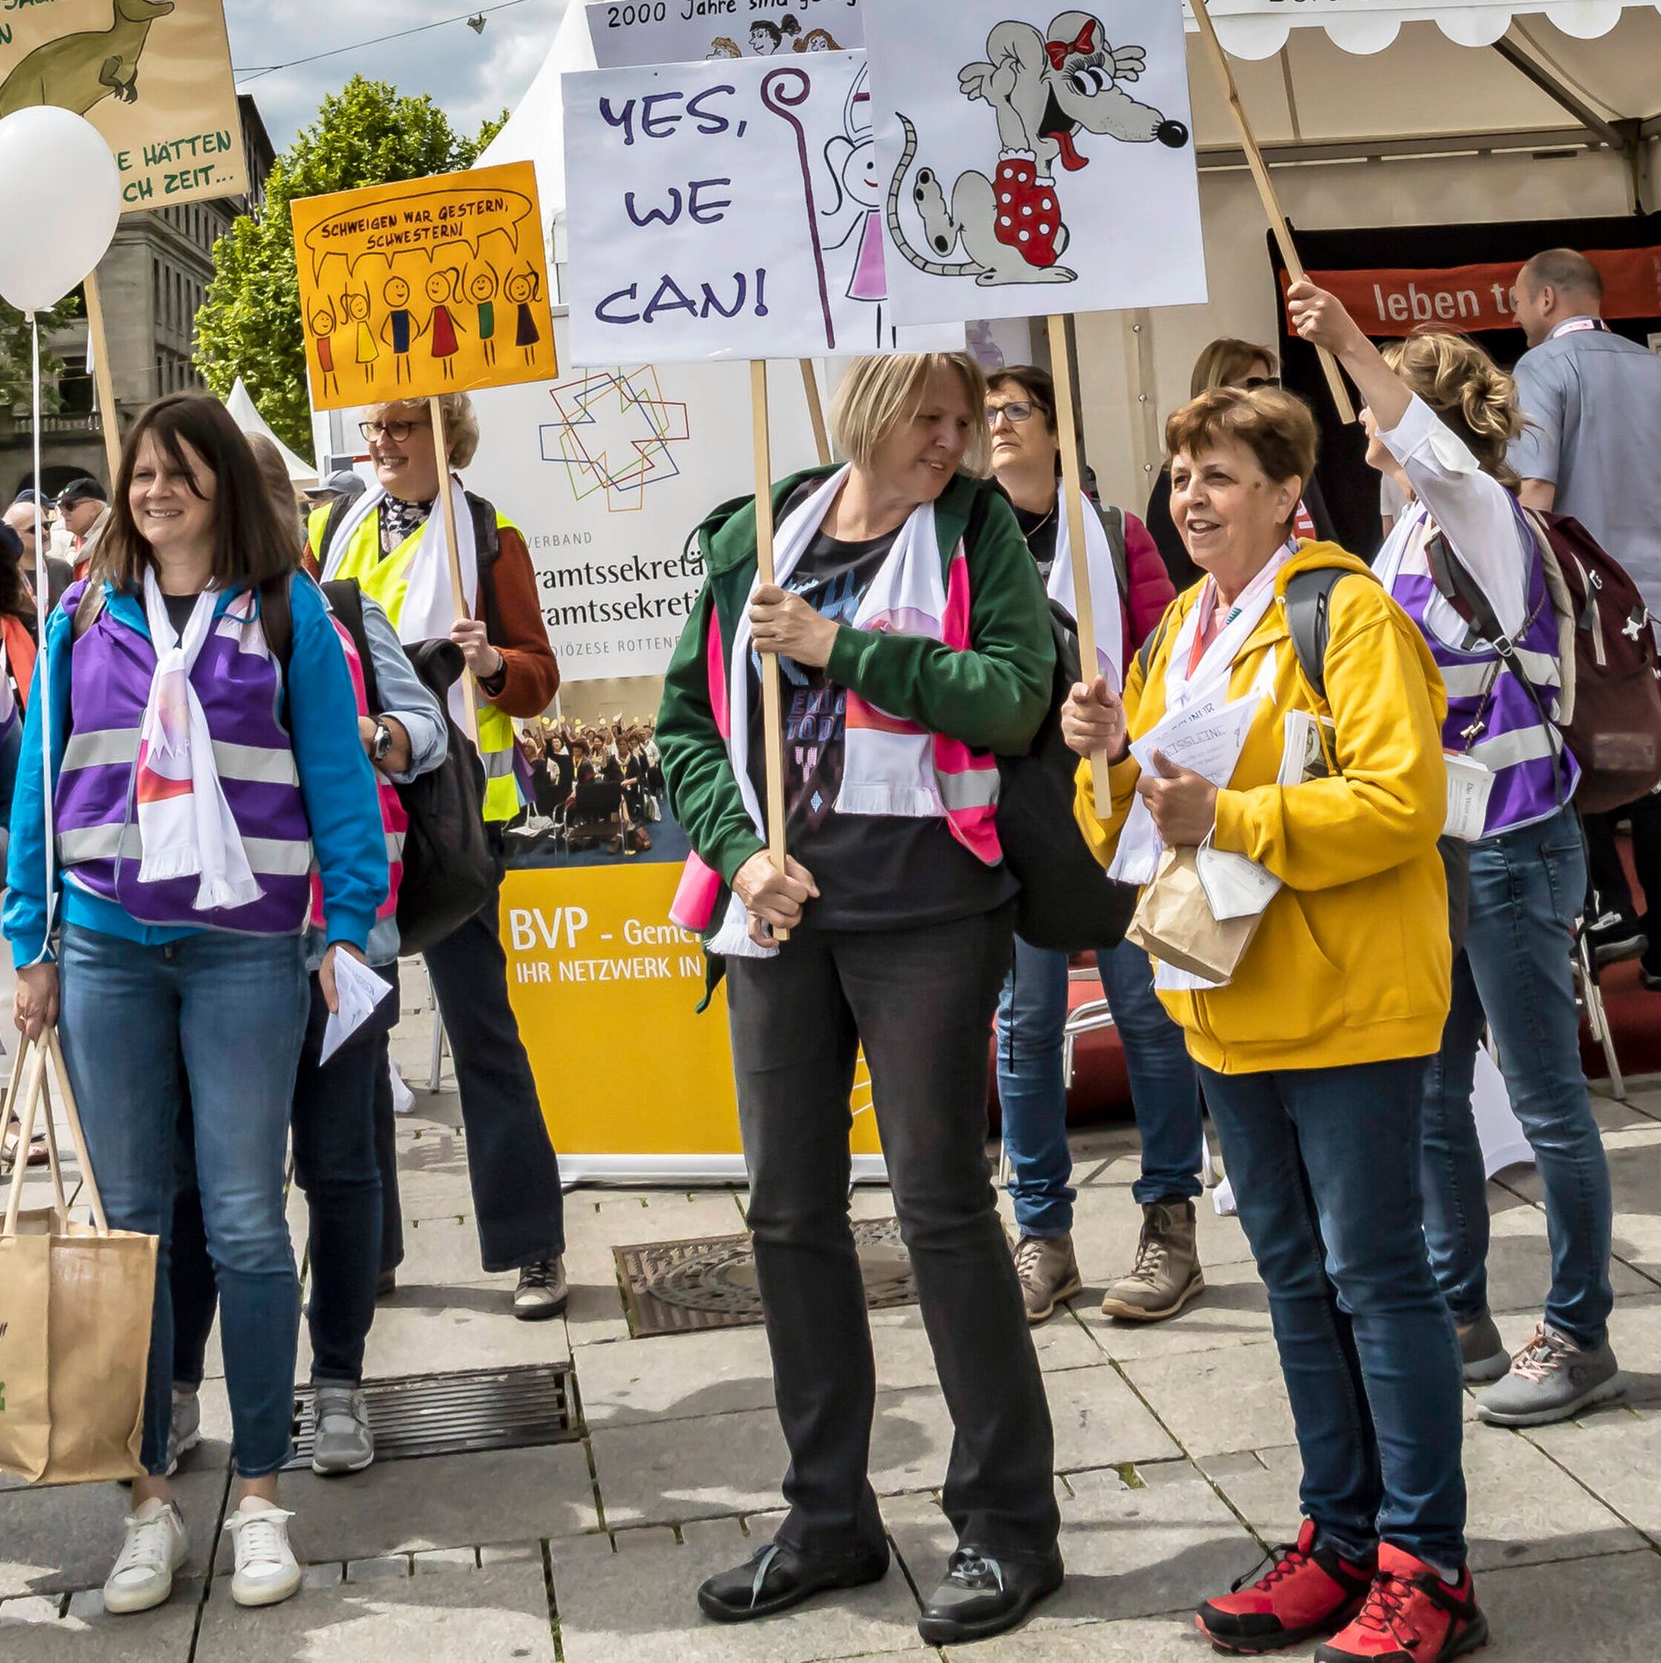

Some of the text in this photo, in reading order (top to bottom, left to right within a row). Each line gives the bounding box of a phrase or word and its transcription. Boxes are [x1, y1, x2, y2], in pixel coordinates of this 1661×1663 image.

[607, 2, 666, 29] 2000
[599, 85, 747, 145] YES,
[144, 130, 232, 167] HÄTTEN
[321, 197, 509, 239] SCHWEIGEN WAR GESTERN,
[624, 178, 732, 227] WE
[366, 222, 464, 250] SCHWESTERN!
[595, 268, 767, 324] CAN!
[1374, 283, 1480, 321] leben
[509, 906, 588, 951] BVP
[516, 955, 702, 983] IHR NETZWERK IN
